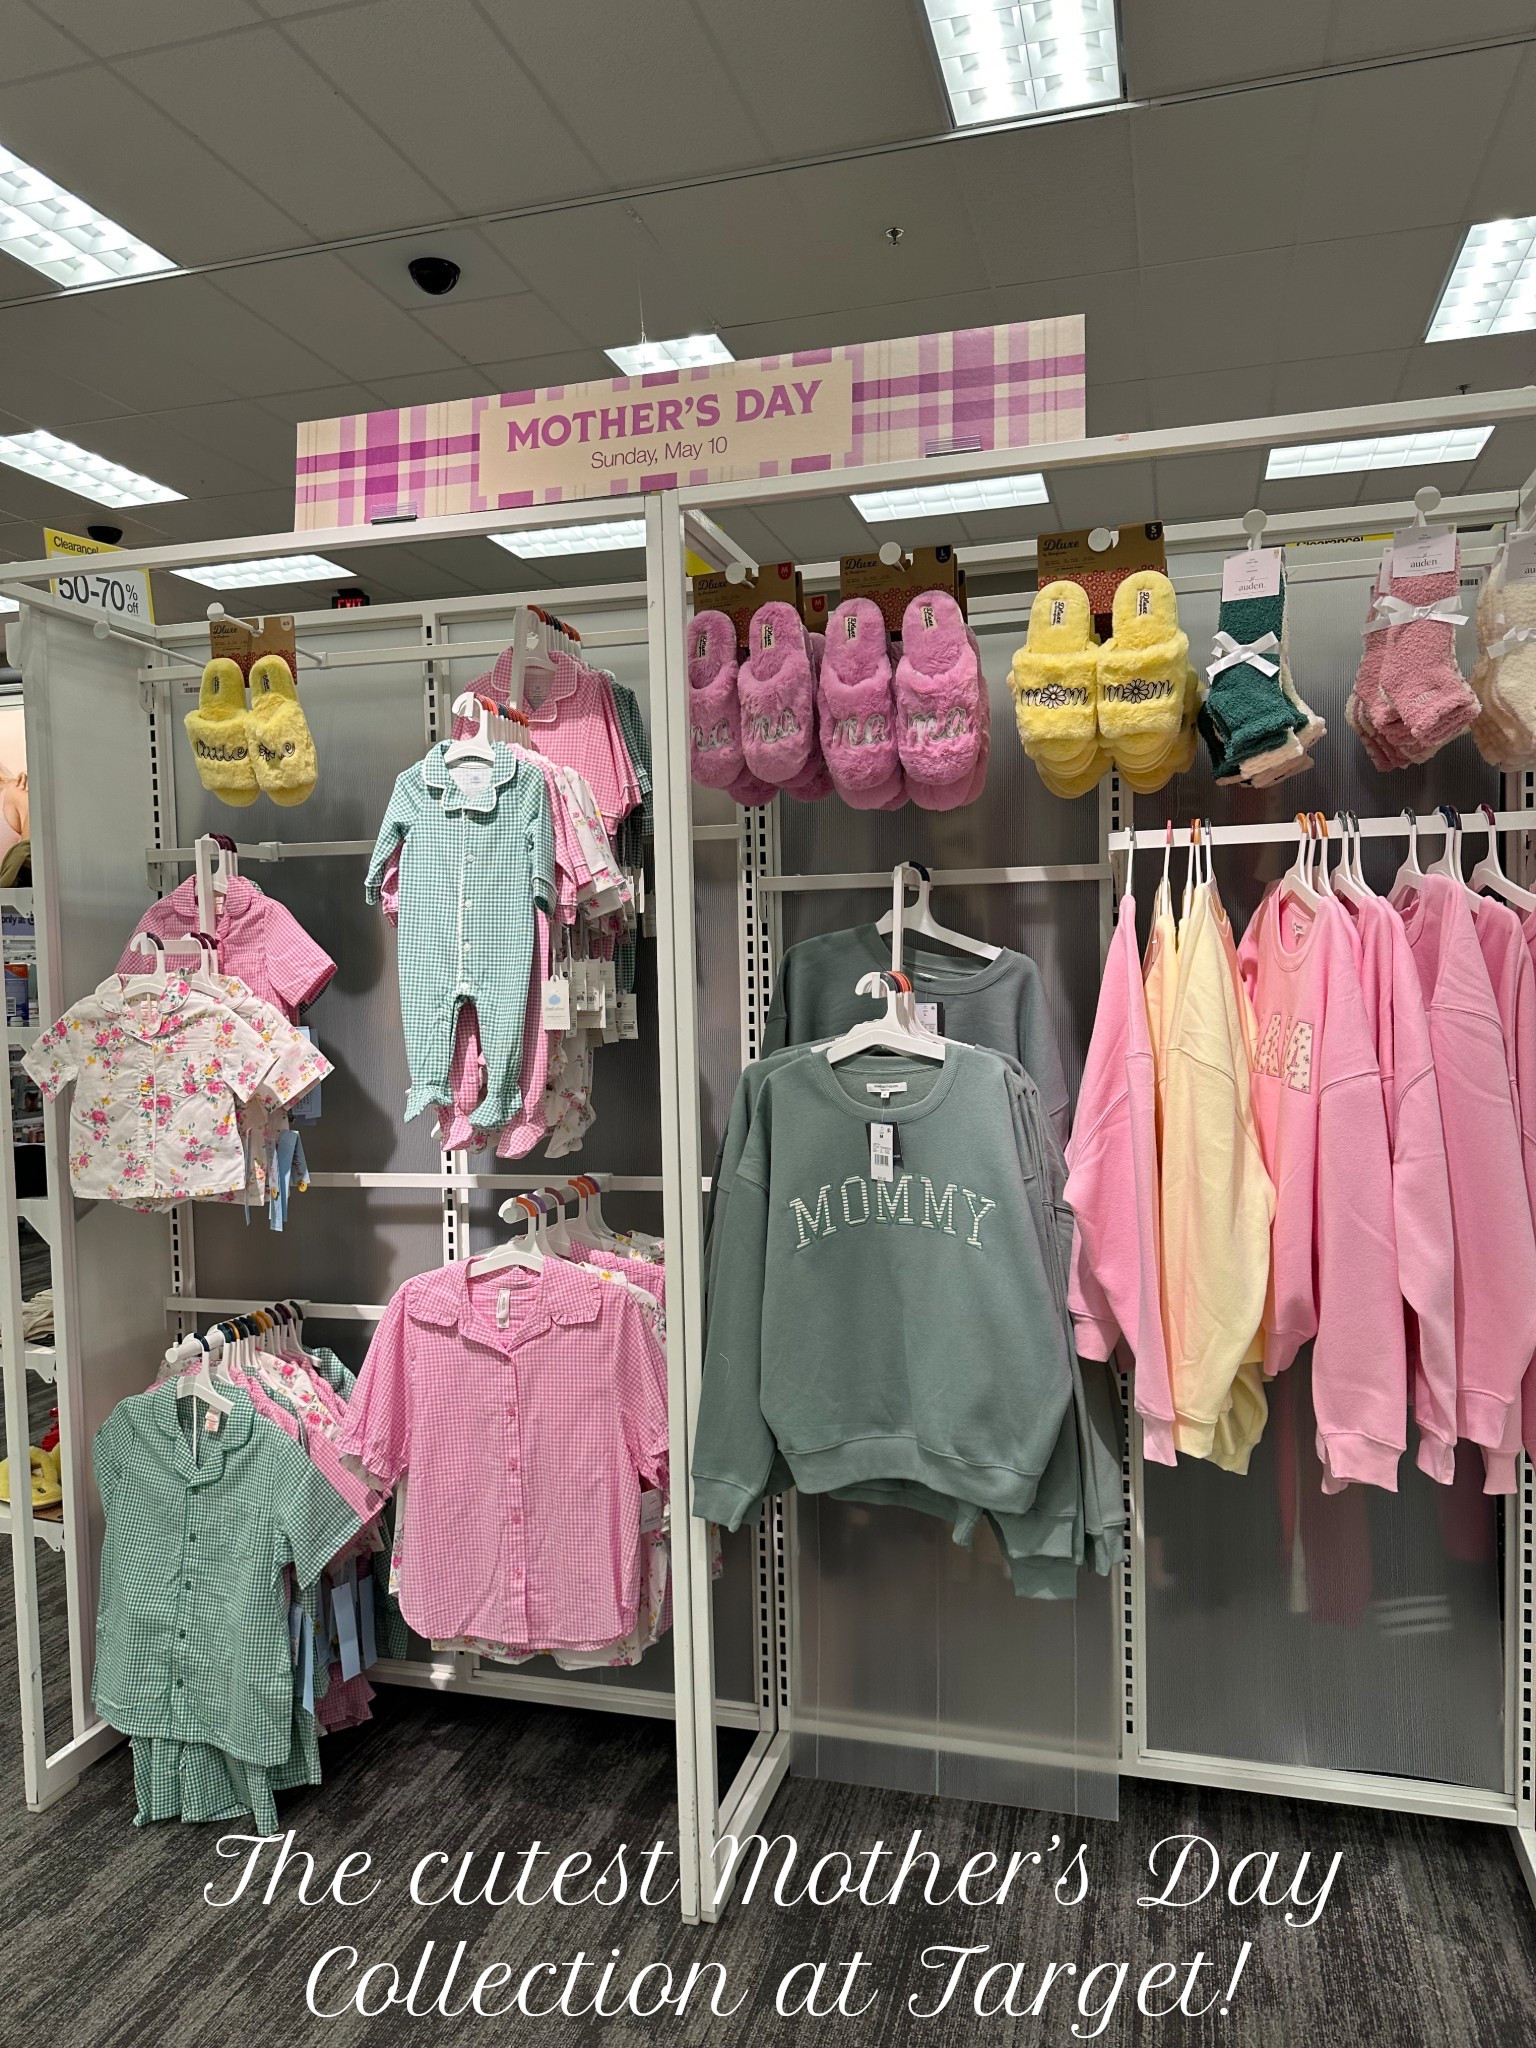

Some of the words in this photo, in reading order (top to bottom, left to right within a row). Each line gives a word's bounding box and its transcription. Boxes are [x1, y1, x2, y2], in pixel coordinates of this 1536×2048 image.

[506, 393, 721, 453] MOTHER'S
[735, 379, 823, 423] DAY
[591, 447, 658, 470] Sunday,
[664, 440, 702, 463] May
[708, 436, 728, 455] 10
[53, 535, 99, 555] Clearance!
[1042, 538, 1079, 552] Dluxe
[844, 558, 878, 570] Dluxe
[1410, 558, 1438, 568] auden
[1238, 581, 1264, 592] auden
[127, 602, 139, 614] off
[788, 1172, 997, 1250] MOMMY
